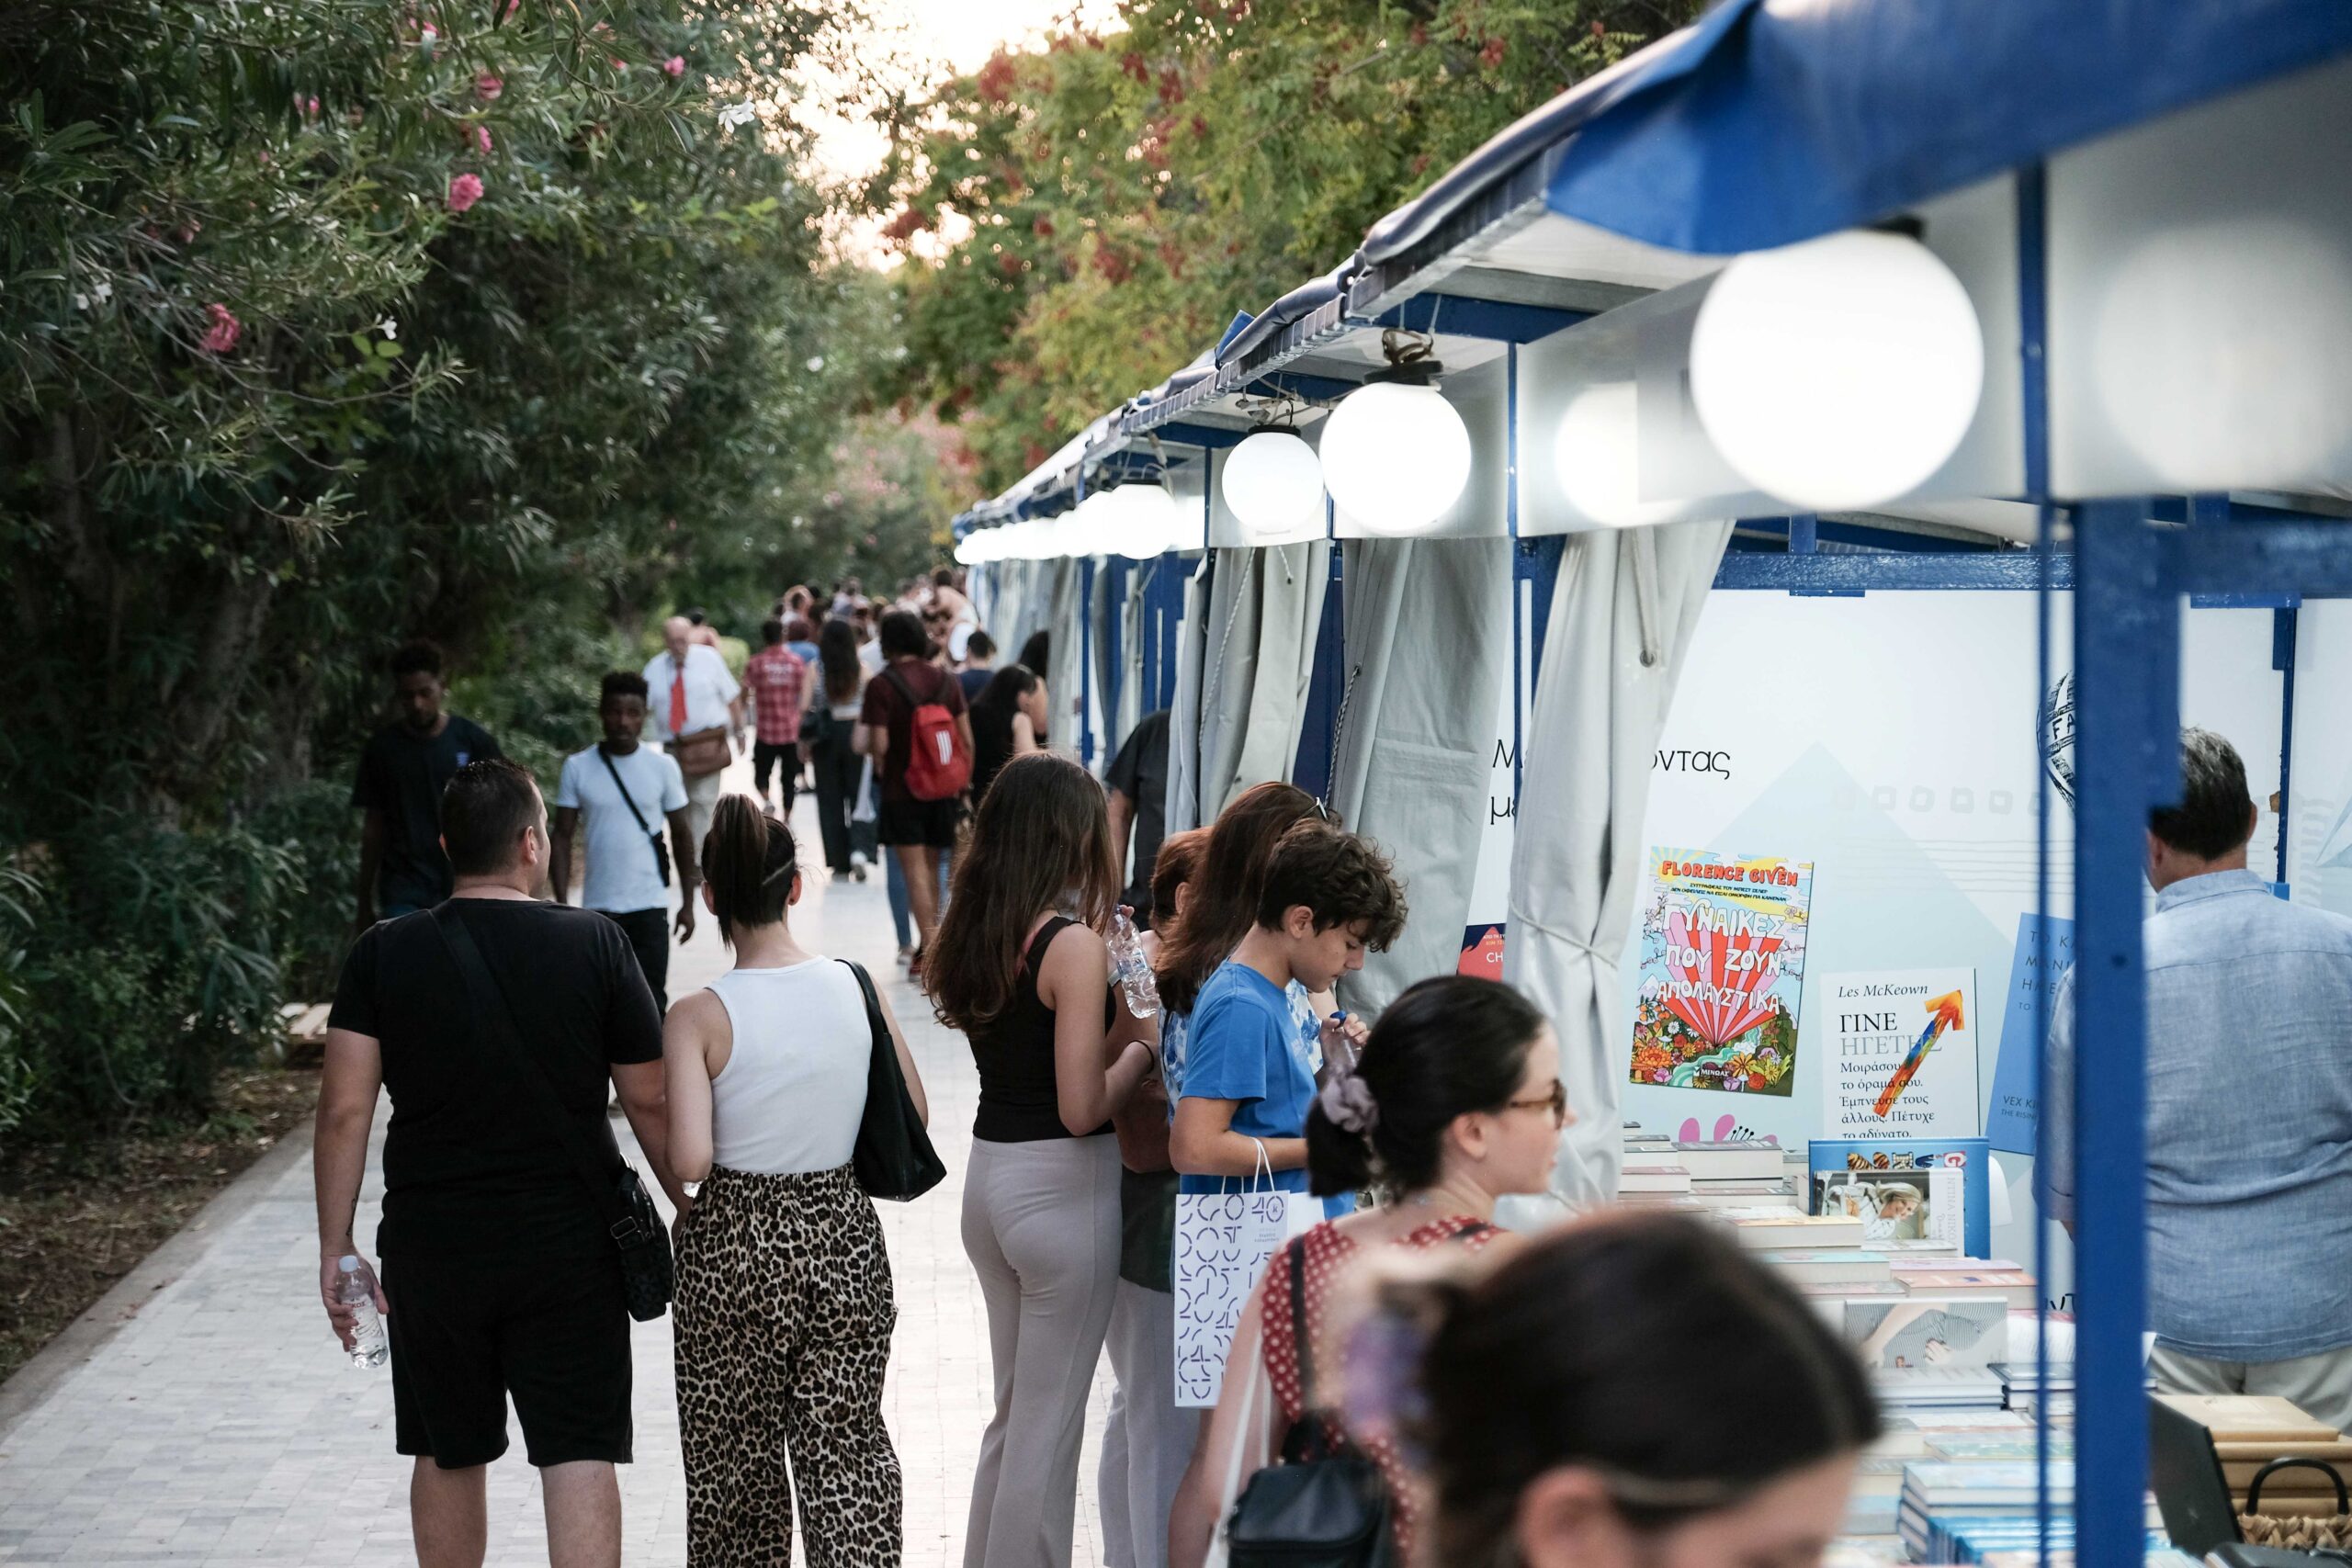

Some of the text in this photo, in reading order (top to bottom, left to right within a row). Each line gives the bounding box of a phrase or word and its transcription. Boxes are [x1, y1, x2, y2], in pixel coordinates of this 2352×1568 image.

[1661, 860, 1799, 886] FLORENCE GIVEN
[1662, 898, 1786, 940] ΓΥΝΑΙΚΕΣ
[1486, 952, 1503, 963] CH
[1665, 944, 1782, 976] ΠΟΥ ΖΟΥΝ
[1657, 980, 1781, 1015] ΑΠΟΛΑΥΣΤΙΚΑ
[1838, 984, 1928, 998] Les McKeown
[1839, 1012, 1898, 1032] ΓΙΝΕ
[1701, 1068, 1729, 1077] ΜΙΝΩΑΣ
[1840, 1062, 1902, 1076] Μοιράσου
[1840, 1077, 1923, 1092] το όραμά σου.
[1838, 1095, 1929, 1110] Έμπνευσε τους
[1841, 1111, 1935, 1124] άλλους. Πέτυχε
[1842, 1131, 1856, 1139] το
